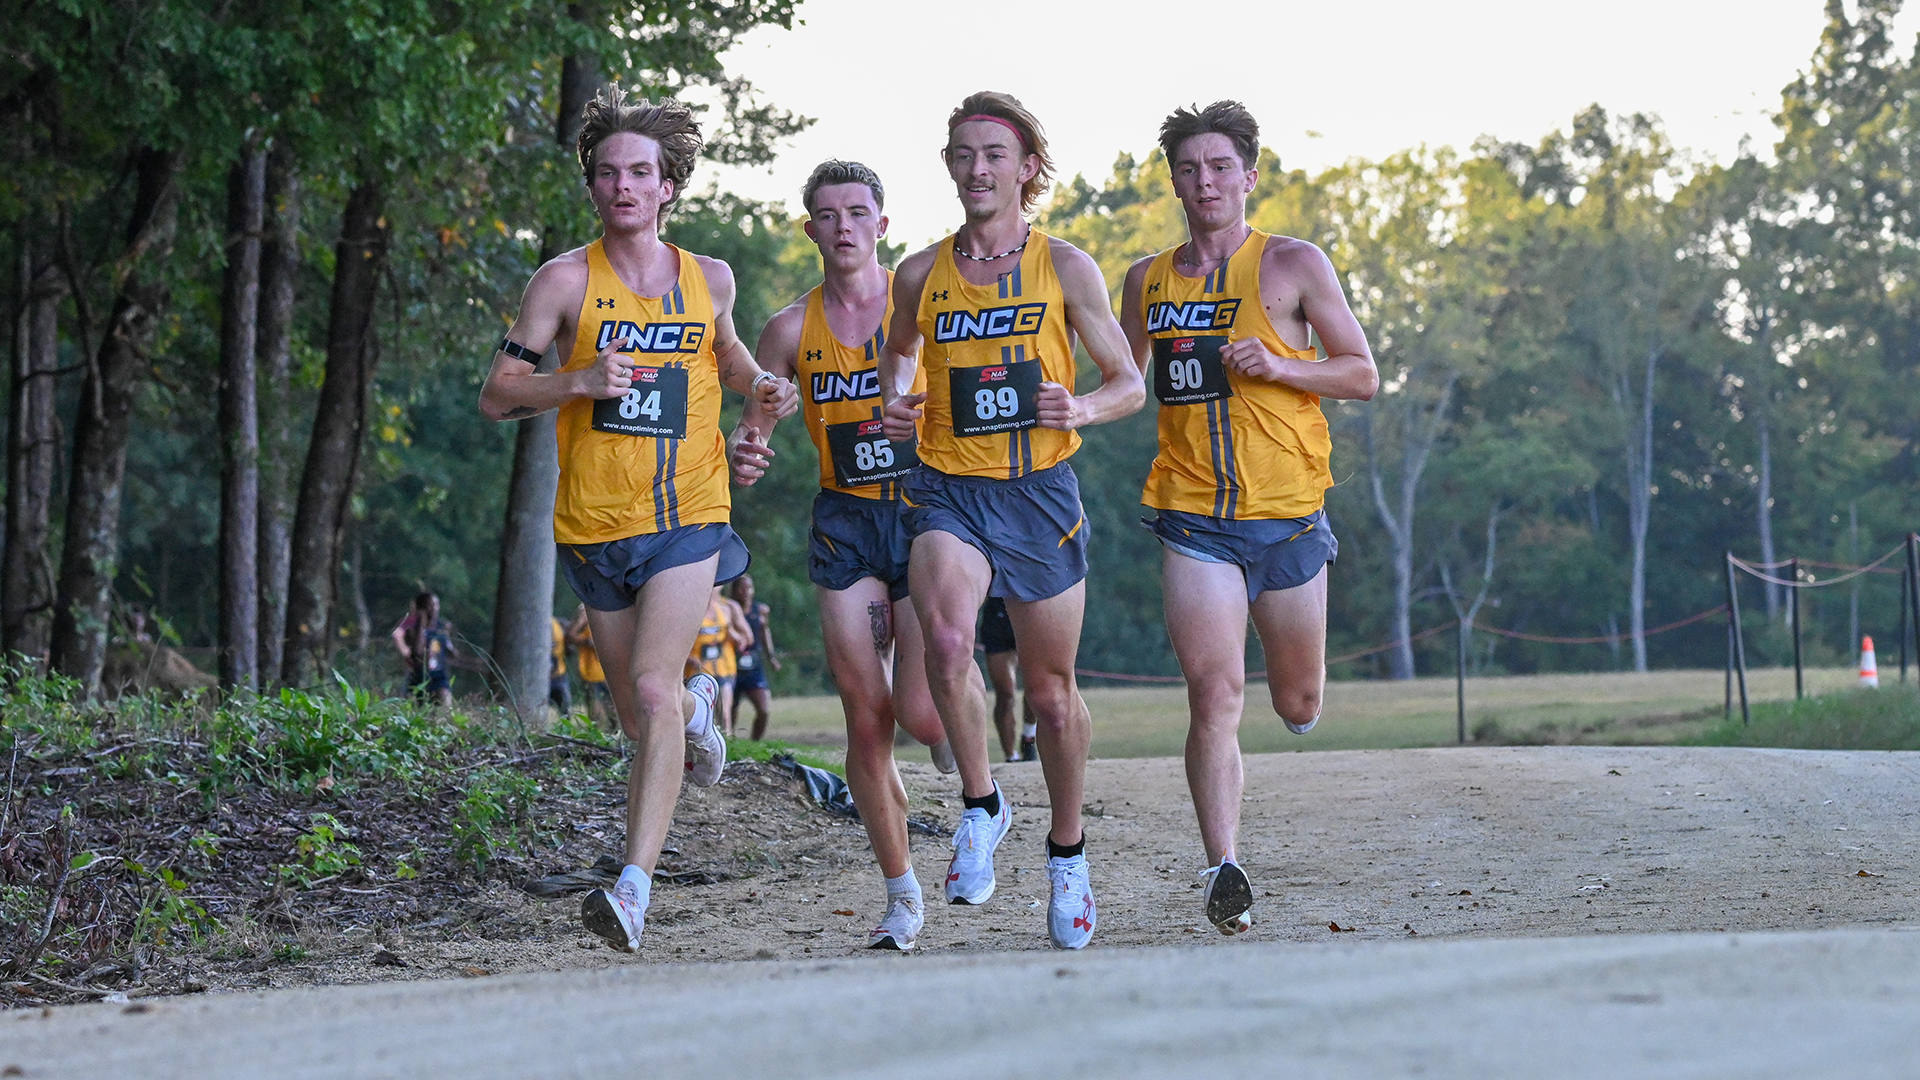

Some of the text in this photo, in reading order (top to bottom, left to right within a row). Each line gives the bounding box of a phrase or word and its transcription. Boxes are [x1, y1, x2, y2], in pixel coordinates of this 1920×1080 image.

[935, 303, 1047, 344] UNCG
[1147, 299, 1242, 335] UNCG
[811, 367, 882, 404] UNC
[1169, 358, 1203, 390] 90
[619, 388, 661, 421] 84
[974, 387, 1018, 420] 89
[603, 421, 673, 435] www.snaptiming.com
[963, 419, 1035, 433] www.snaptiming.com
[854, 438, 895, 470] 85
